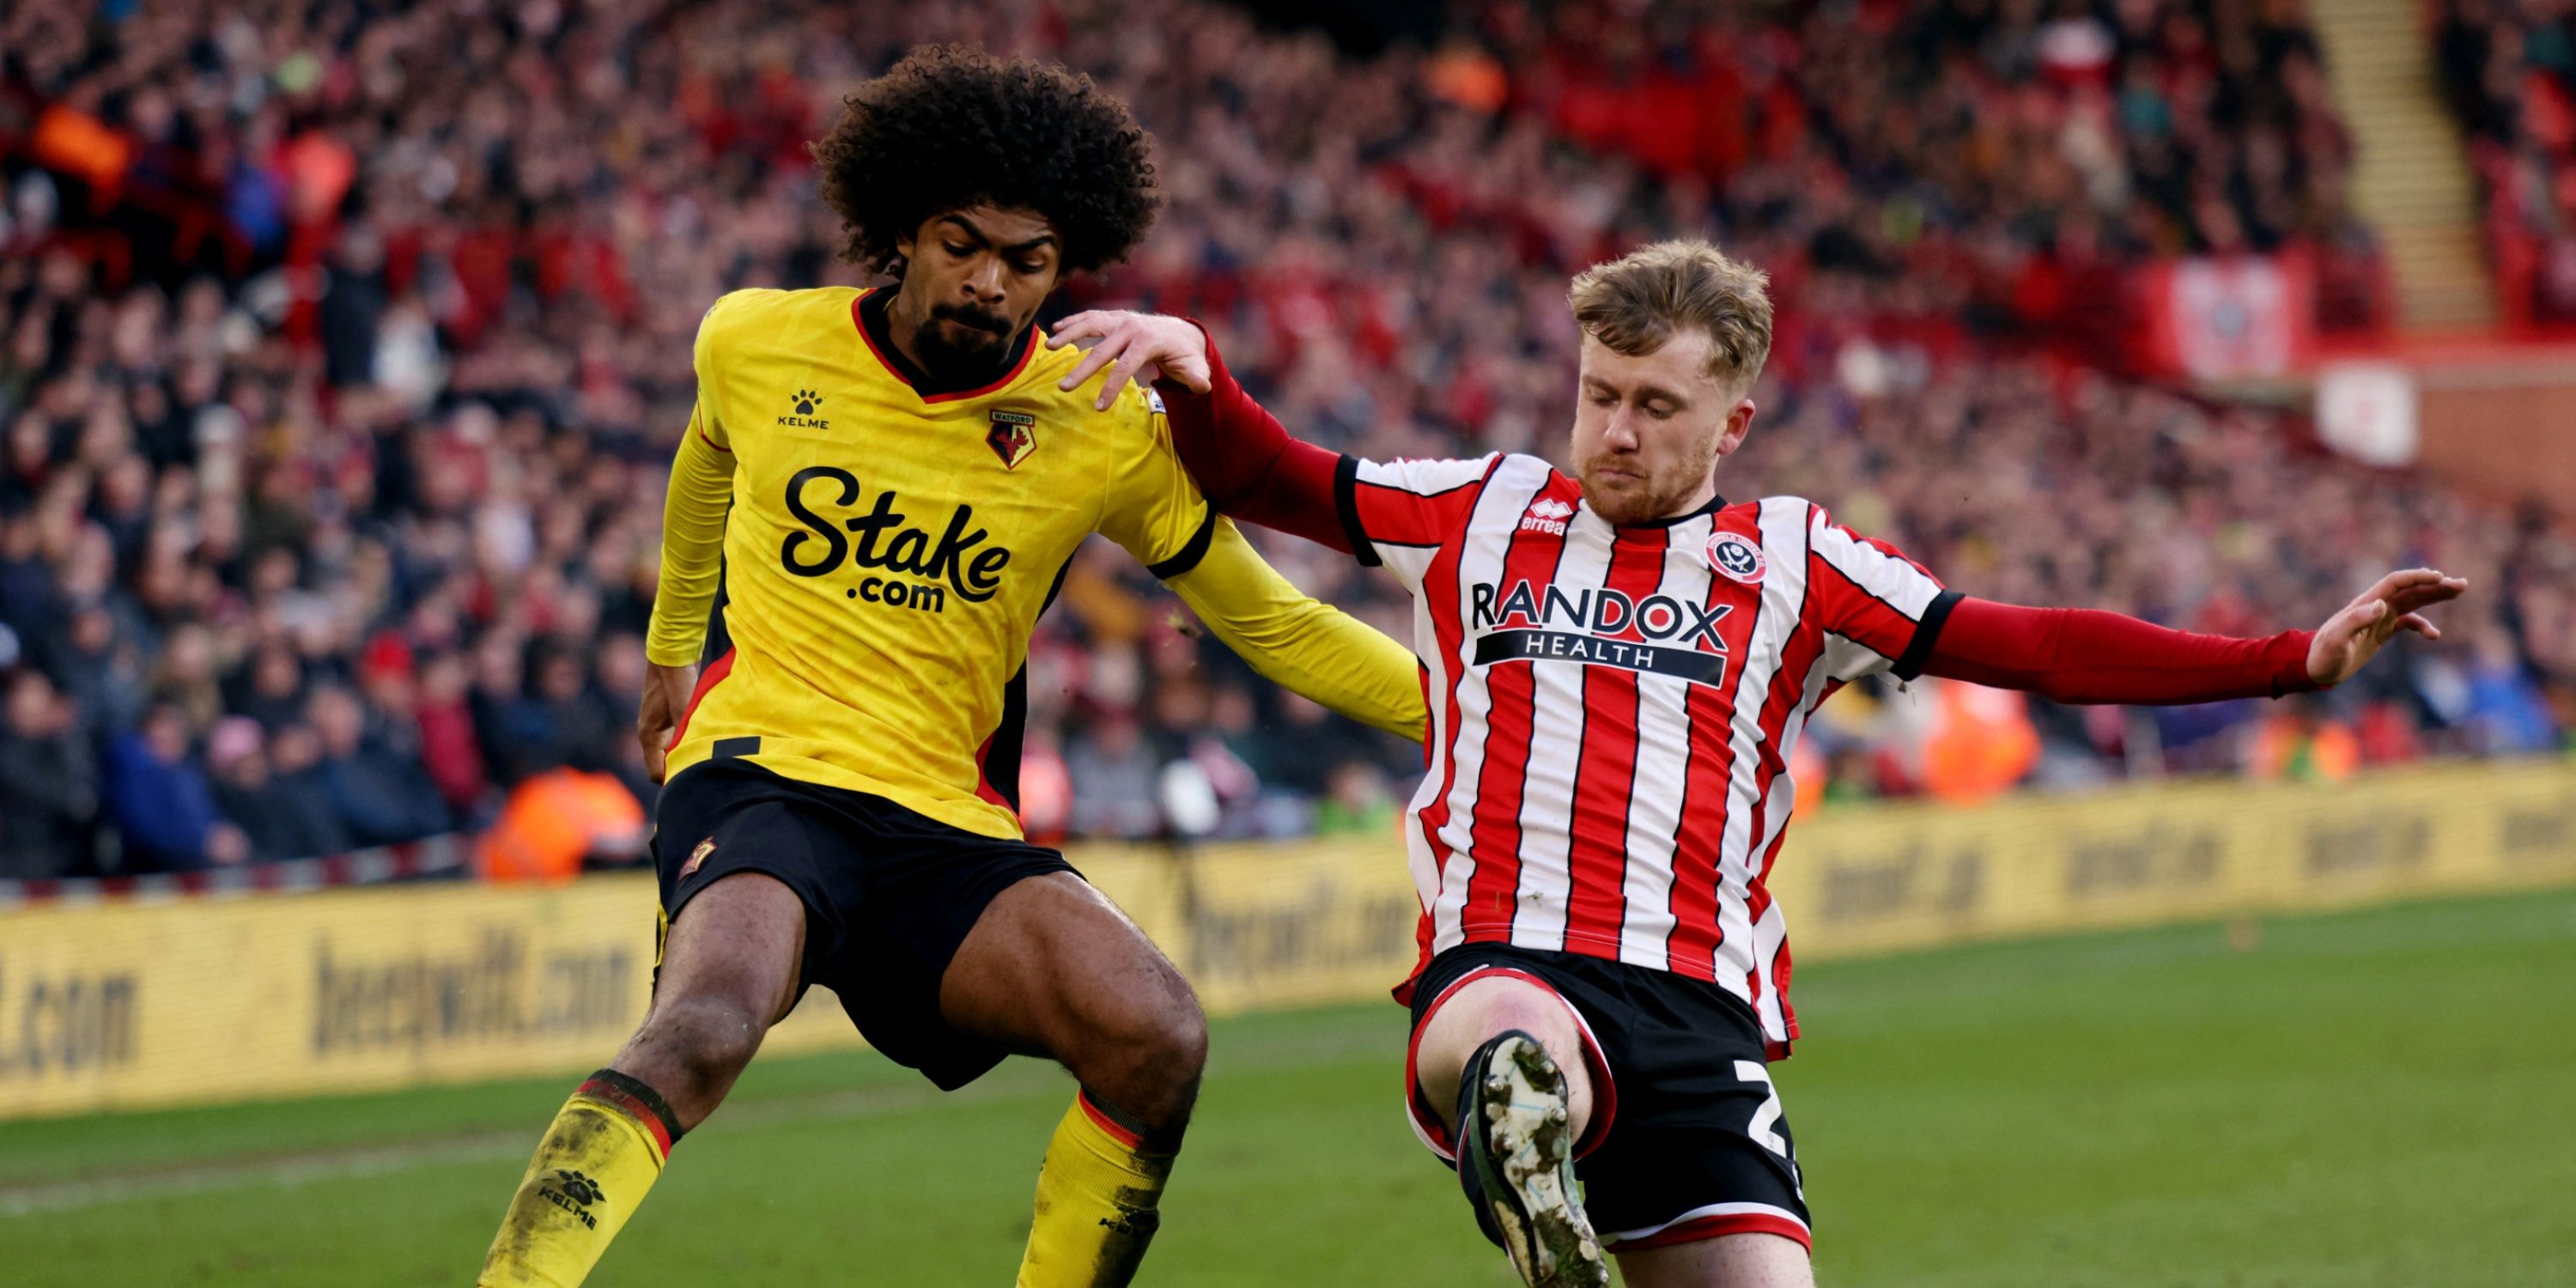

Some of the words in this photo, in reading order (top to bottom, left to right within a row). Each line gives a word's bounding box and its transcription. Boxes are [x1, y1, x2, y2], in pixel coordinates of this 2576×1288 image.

[778, 416, 829, 430] KELME
[994, 411, 1032, 424] WATFORD
[781, 466, 1012, 603] Stake
[847, 577, 945, 613] .com
[1472, 580, 1734, 652] RANDOX
[1526, 635, 1654, 669] HEALTH
[0, 966, 142, 1073] .com
[1733, 1060, 1795, 1160] 2
[538, 1186, 598, 1231] KELME
